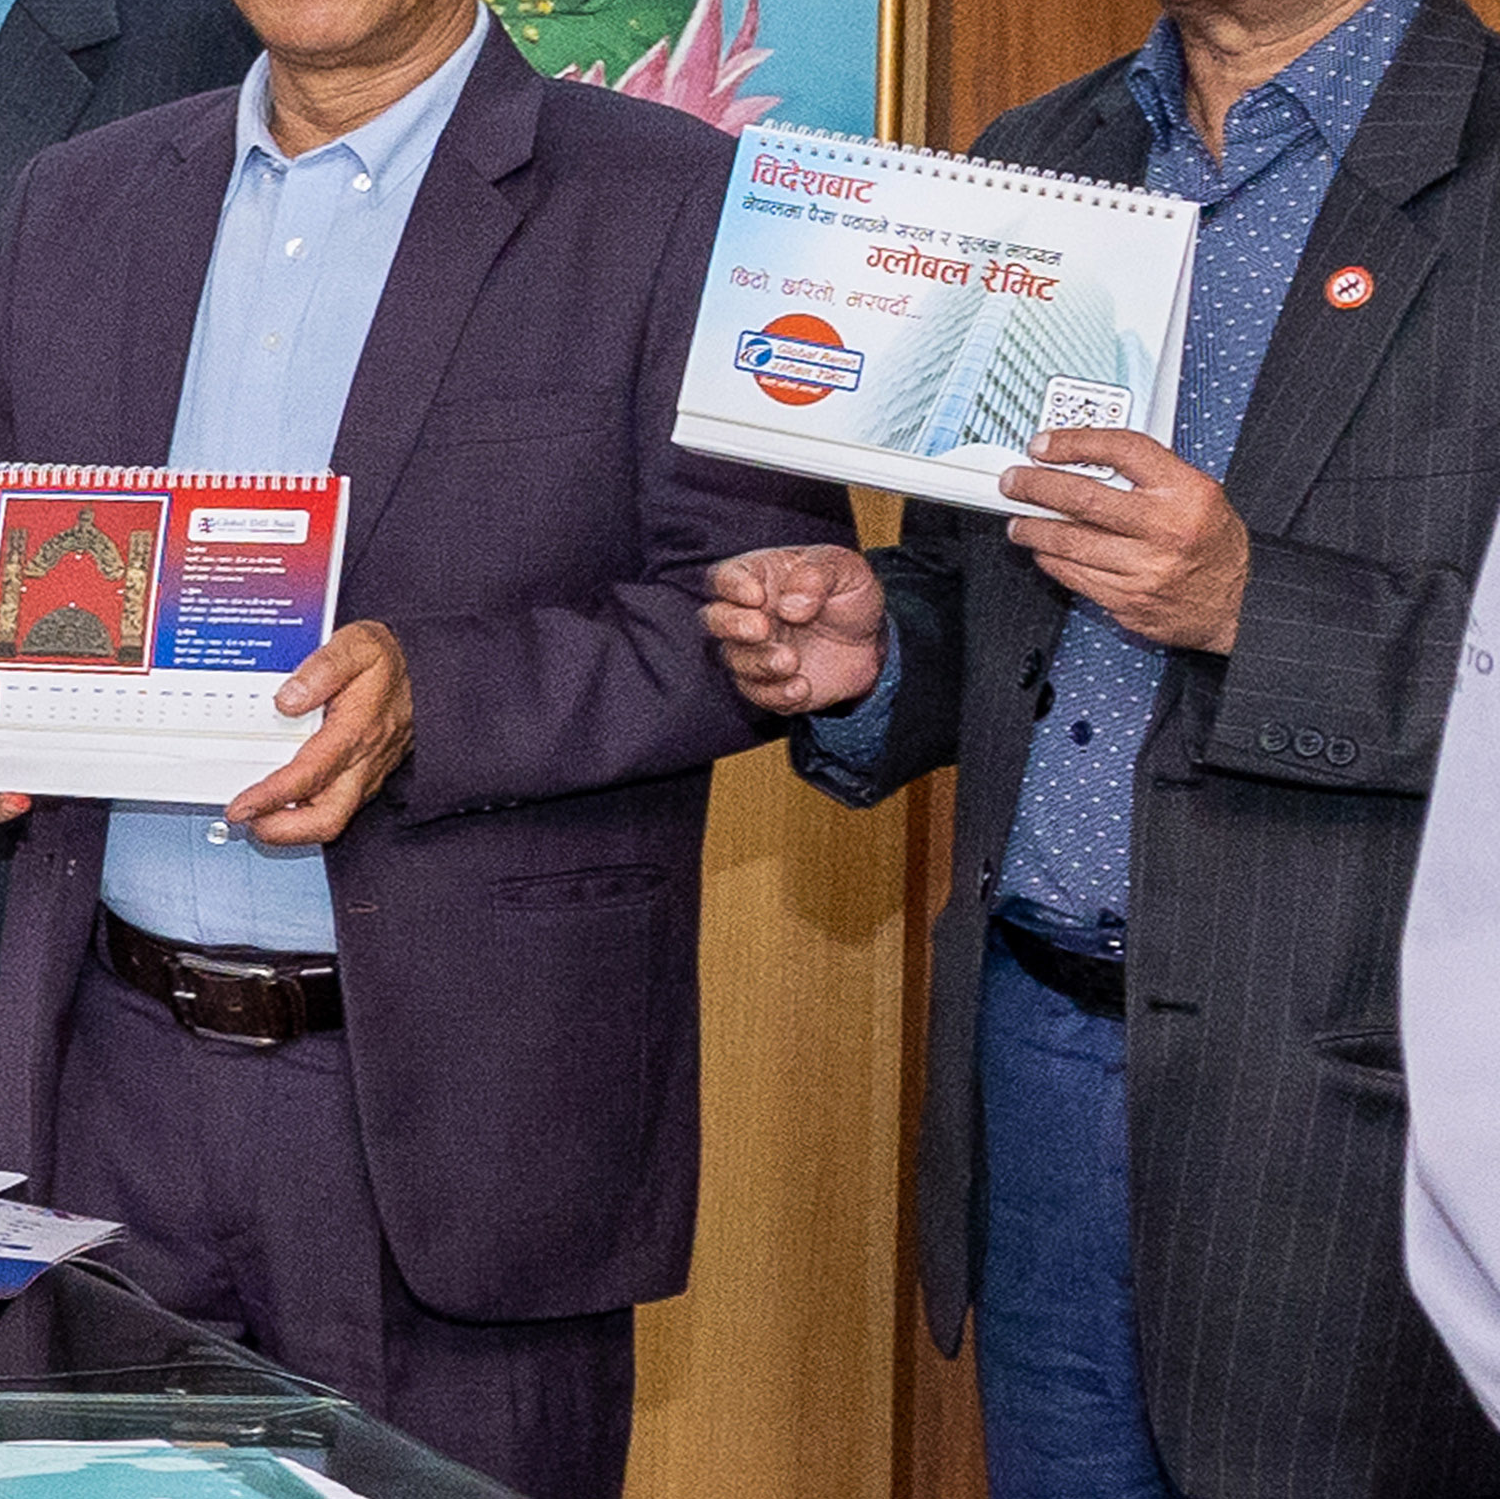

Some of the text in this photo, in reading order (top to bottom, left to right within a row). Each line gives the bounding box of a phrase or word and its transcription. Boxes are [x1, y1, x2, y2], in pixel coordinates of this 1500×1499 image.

[750, 153, 878, 204] विदेशबाट
[866, 244, 1061, 301] ग्लोबल रेमिट
